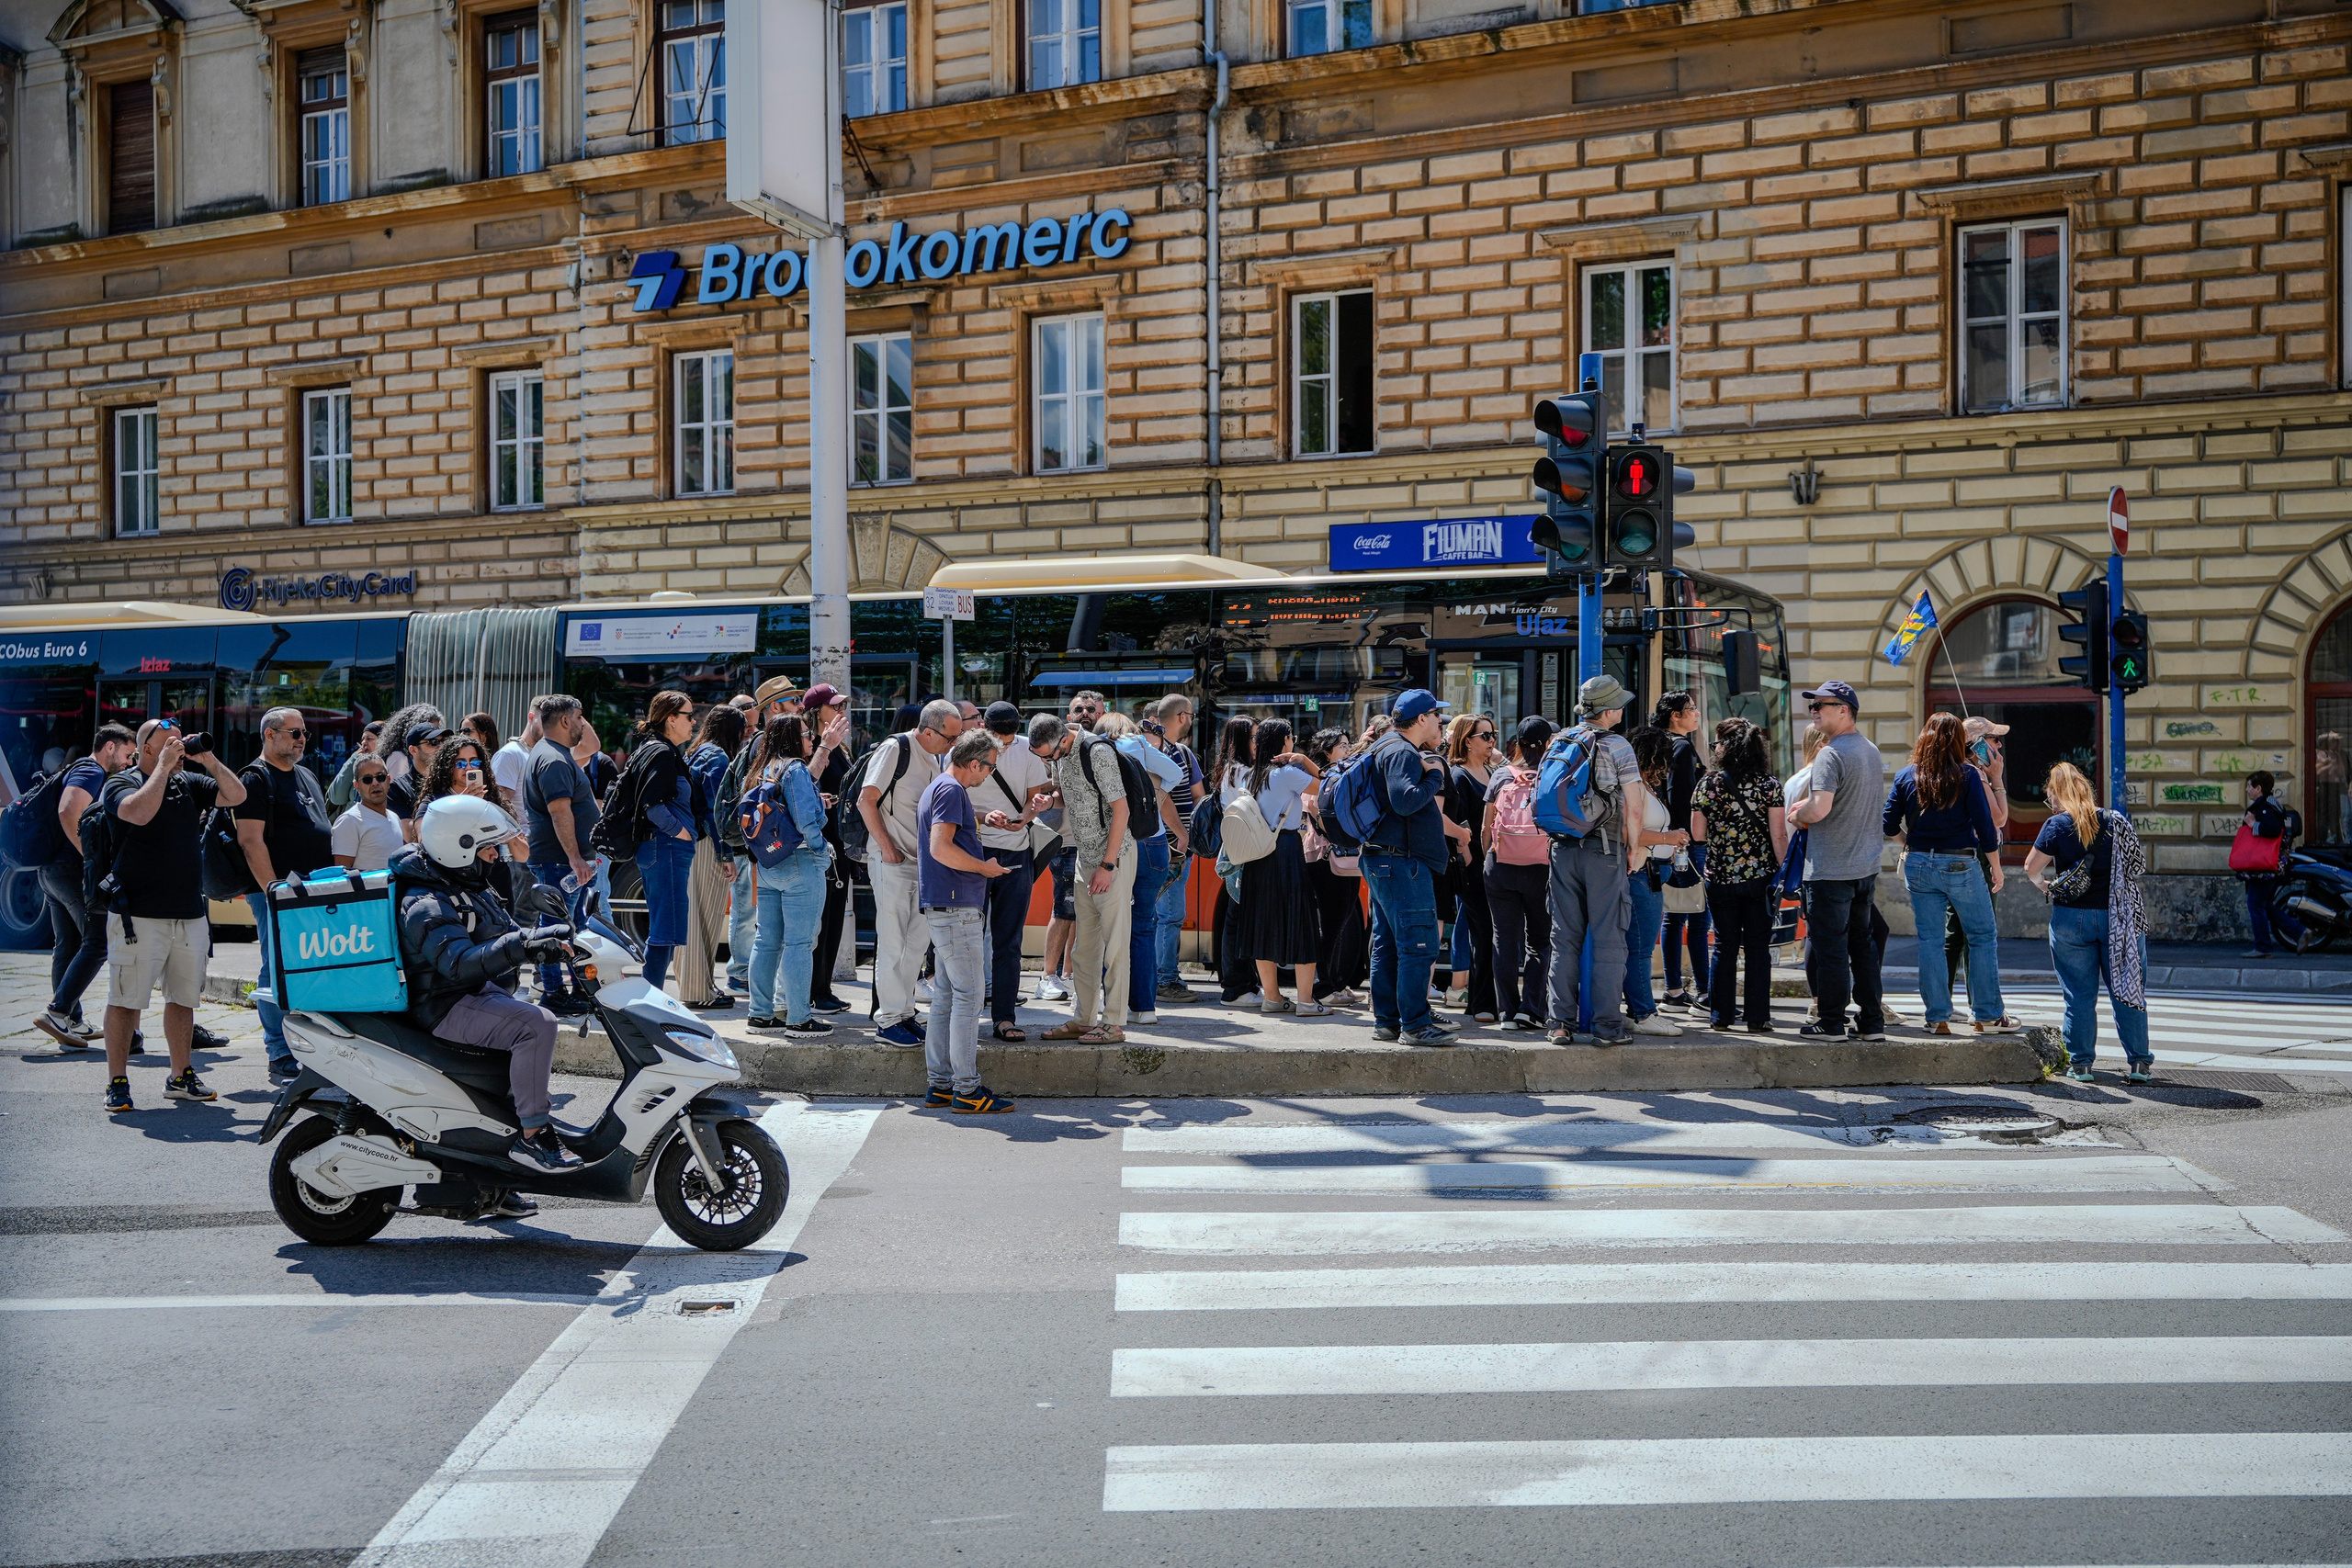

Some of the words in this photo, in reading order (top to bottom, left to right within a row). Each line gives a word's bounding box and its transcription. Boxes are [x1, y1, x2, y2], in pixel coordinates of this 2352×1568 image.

[697, 207, 1134, 305] Brookomerc
[1423, 520, 1503, 561] FIUMAN
[1442, 551, 1467, 560] CAFFE
[1468, 551, 1484, 559] BAR
[925, 596, 935, 609] 32
[957, 595, 973, 614] BUS
[1454, 604, 1507, 615] MAN
[1510, 606, 1537, 615] Lion's
[1540, 605, 1558, 615] City
[1516, 614, 1568, 636] Ulaz
[43, 642, 75, 658] Euro
[78, 641, 88, 657] 6
[140, 656, 171, 672] Izlaz
[299, 924, 375, 960] Wolt
[340, 1141, 400, 1163] www.citycoco.hr
